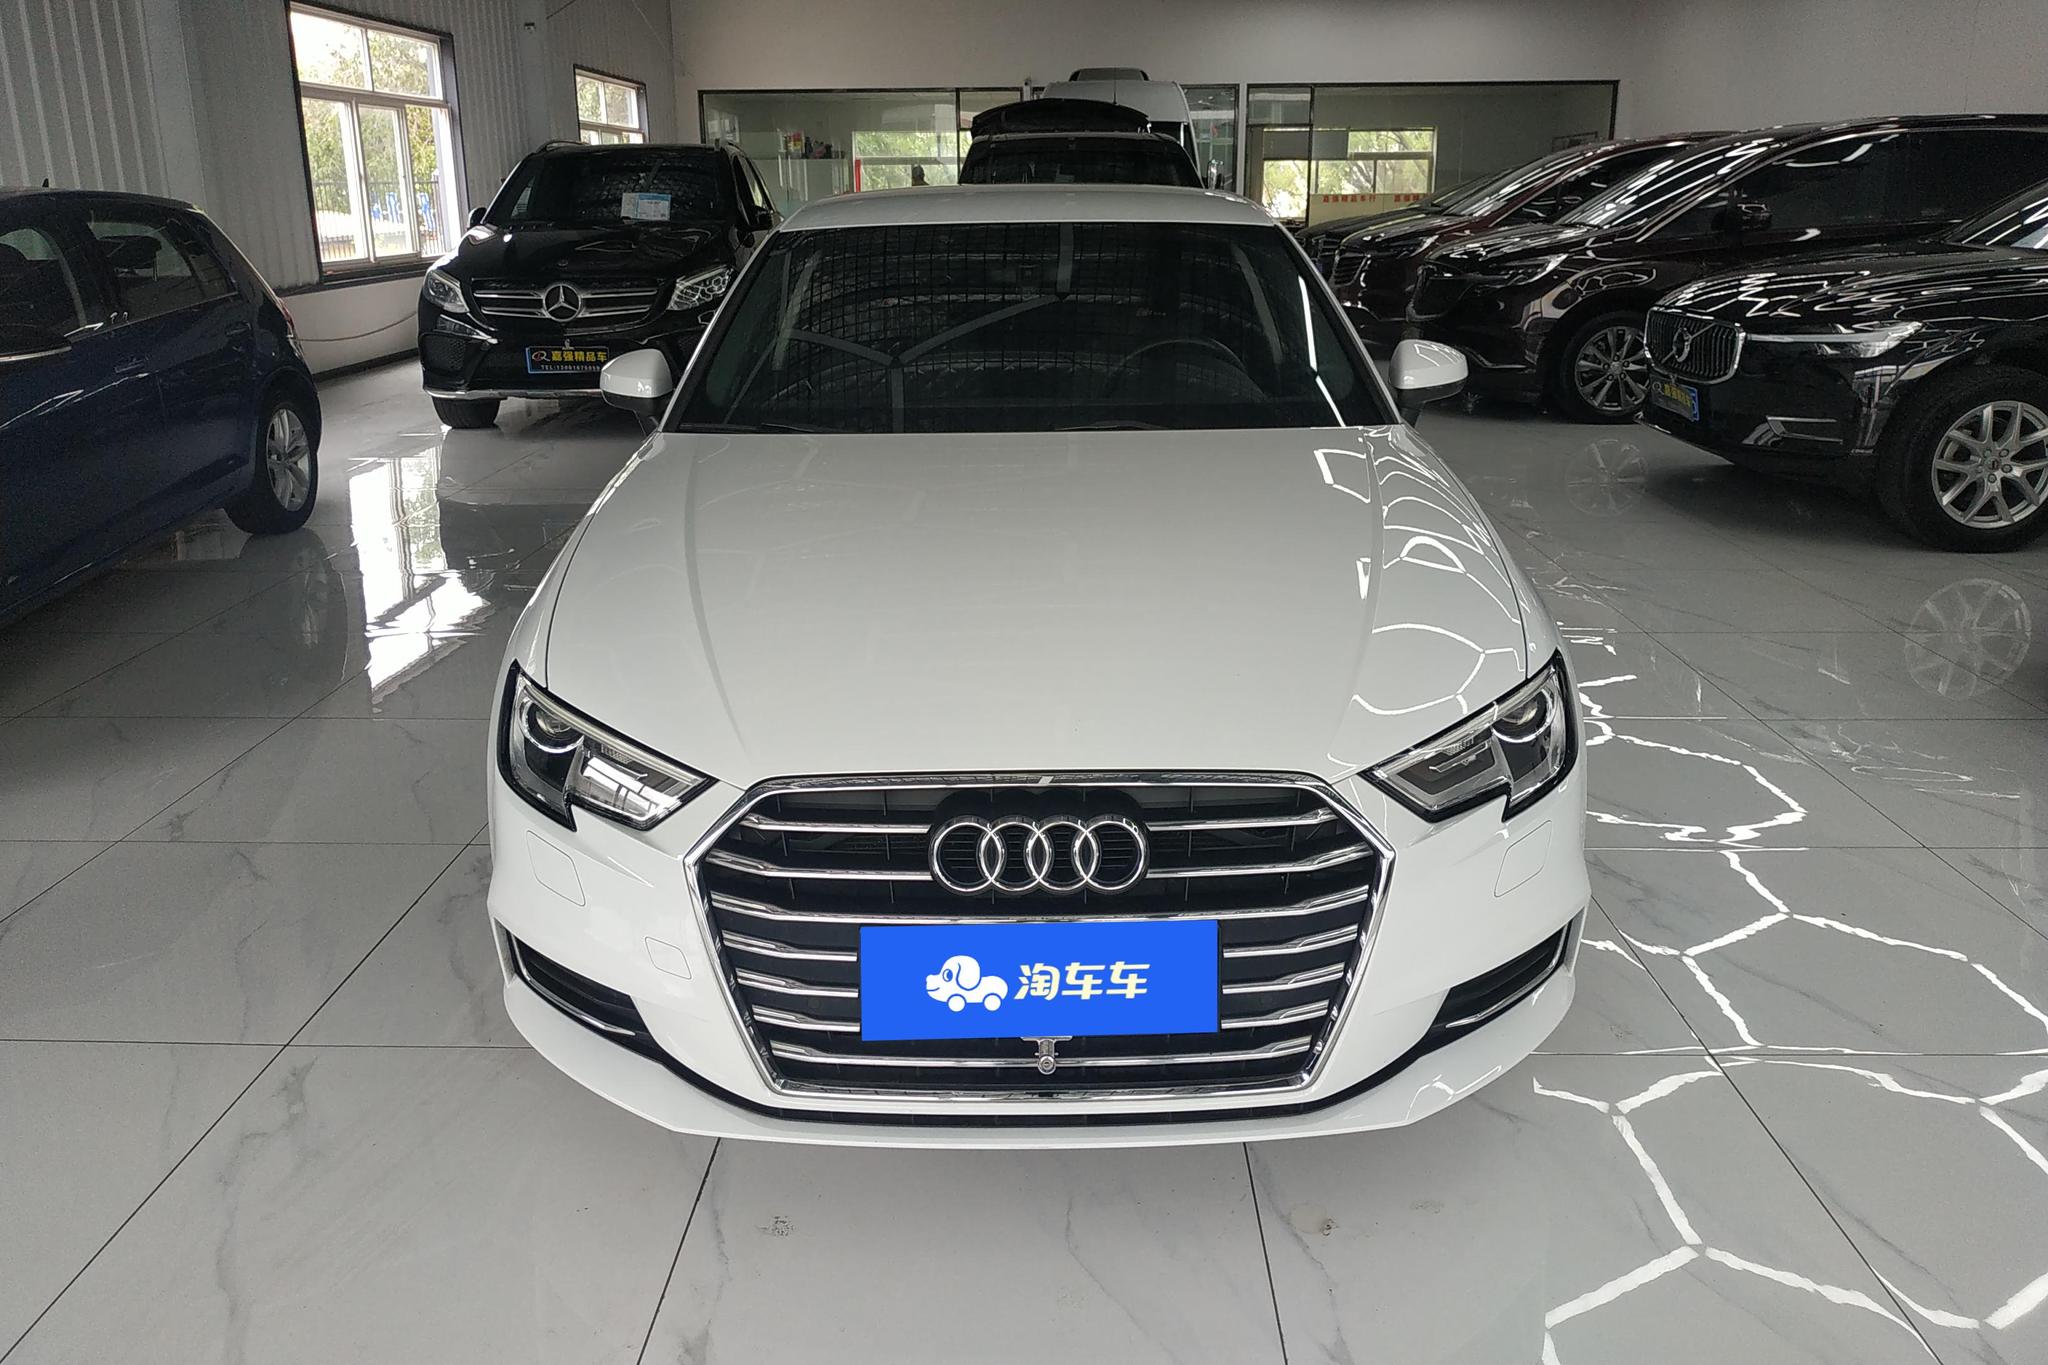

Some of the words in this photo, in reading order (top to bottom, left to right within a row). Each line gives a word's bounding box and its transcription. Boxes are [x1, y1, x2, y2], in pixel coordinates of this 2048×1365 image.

[551, 350, 607, 363] 嘉强精品车
